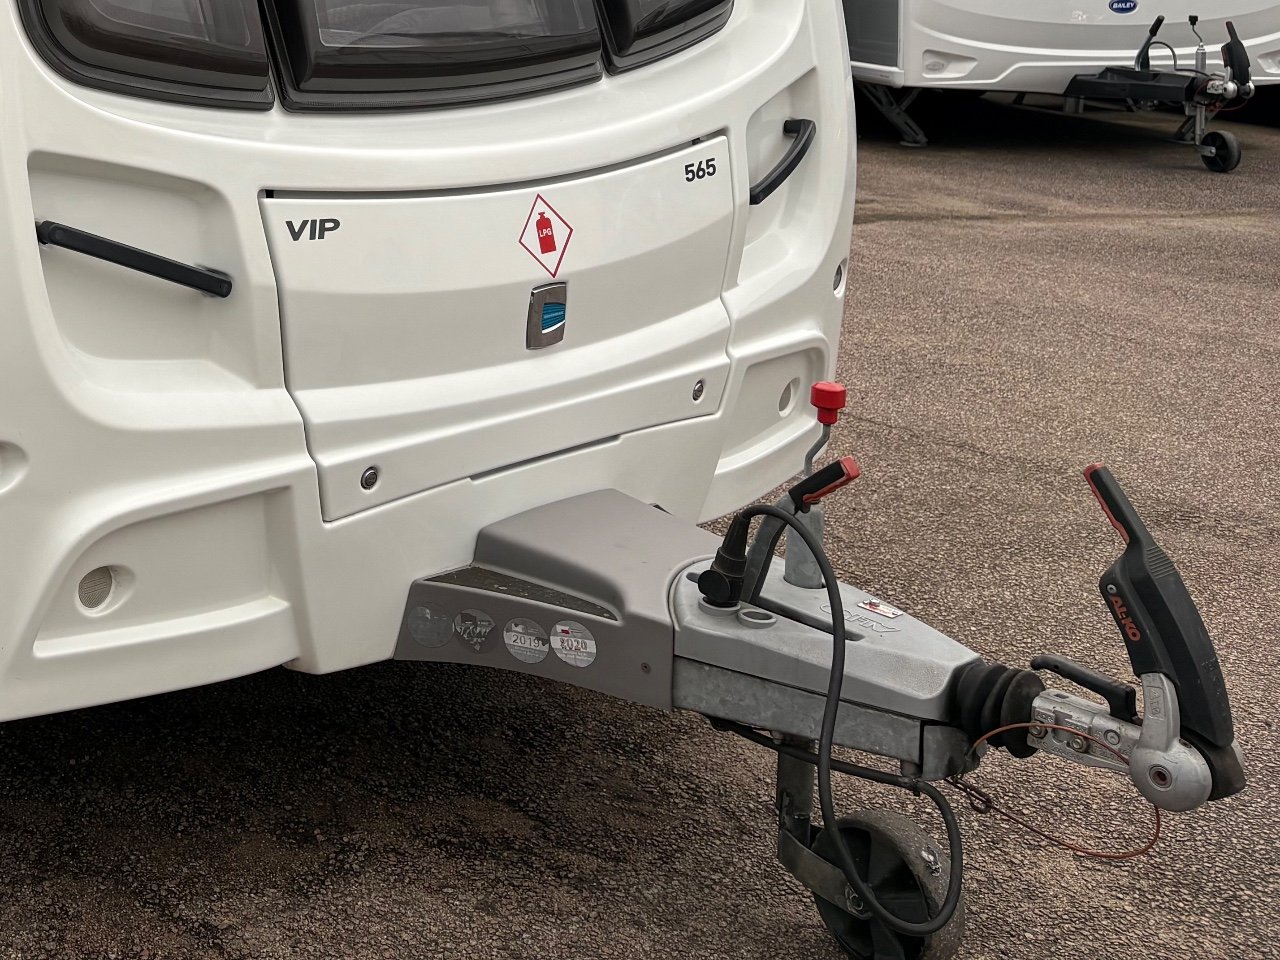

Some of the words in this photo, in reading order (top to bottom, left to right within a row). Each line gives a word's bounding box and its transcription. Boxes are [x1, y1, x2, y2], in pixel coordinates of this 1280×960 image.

[684, 157, 717, 182] 565
[285, 218, 341, 242] VIP
[538, 227, 553, 238] LPG
[512, 633, 540, 648] 2019
